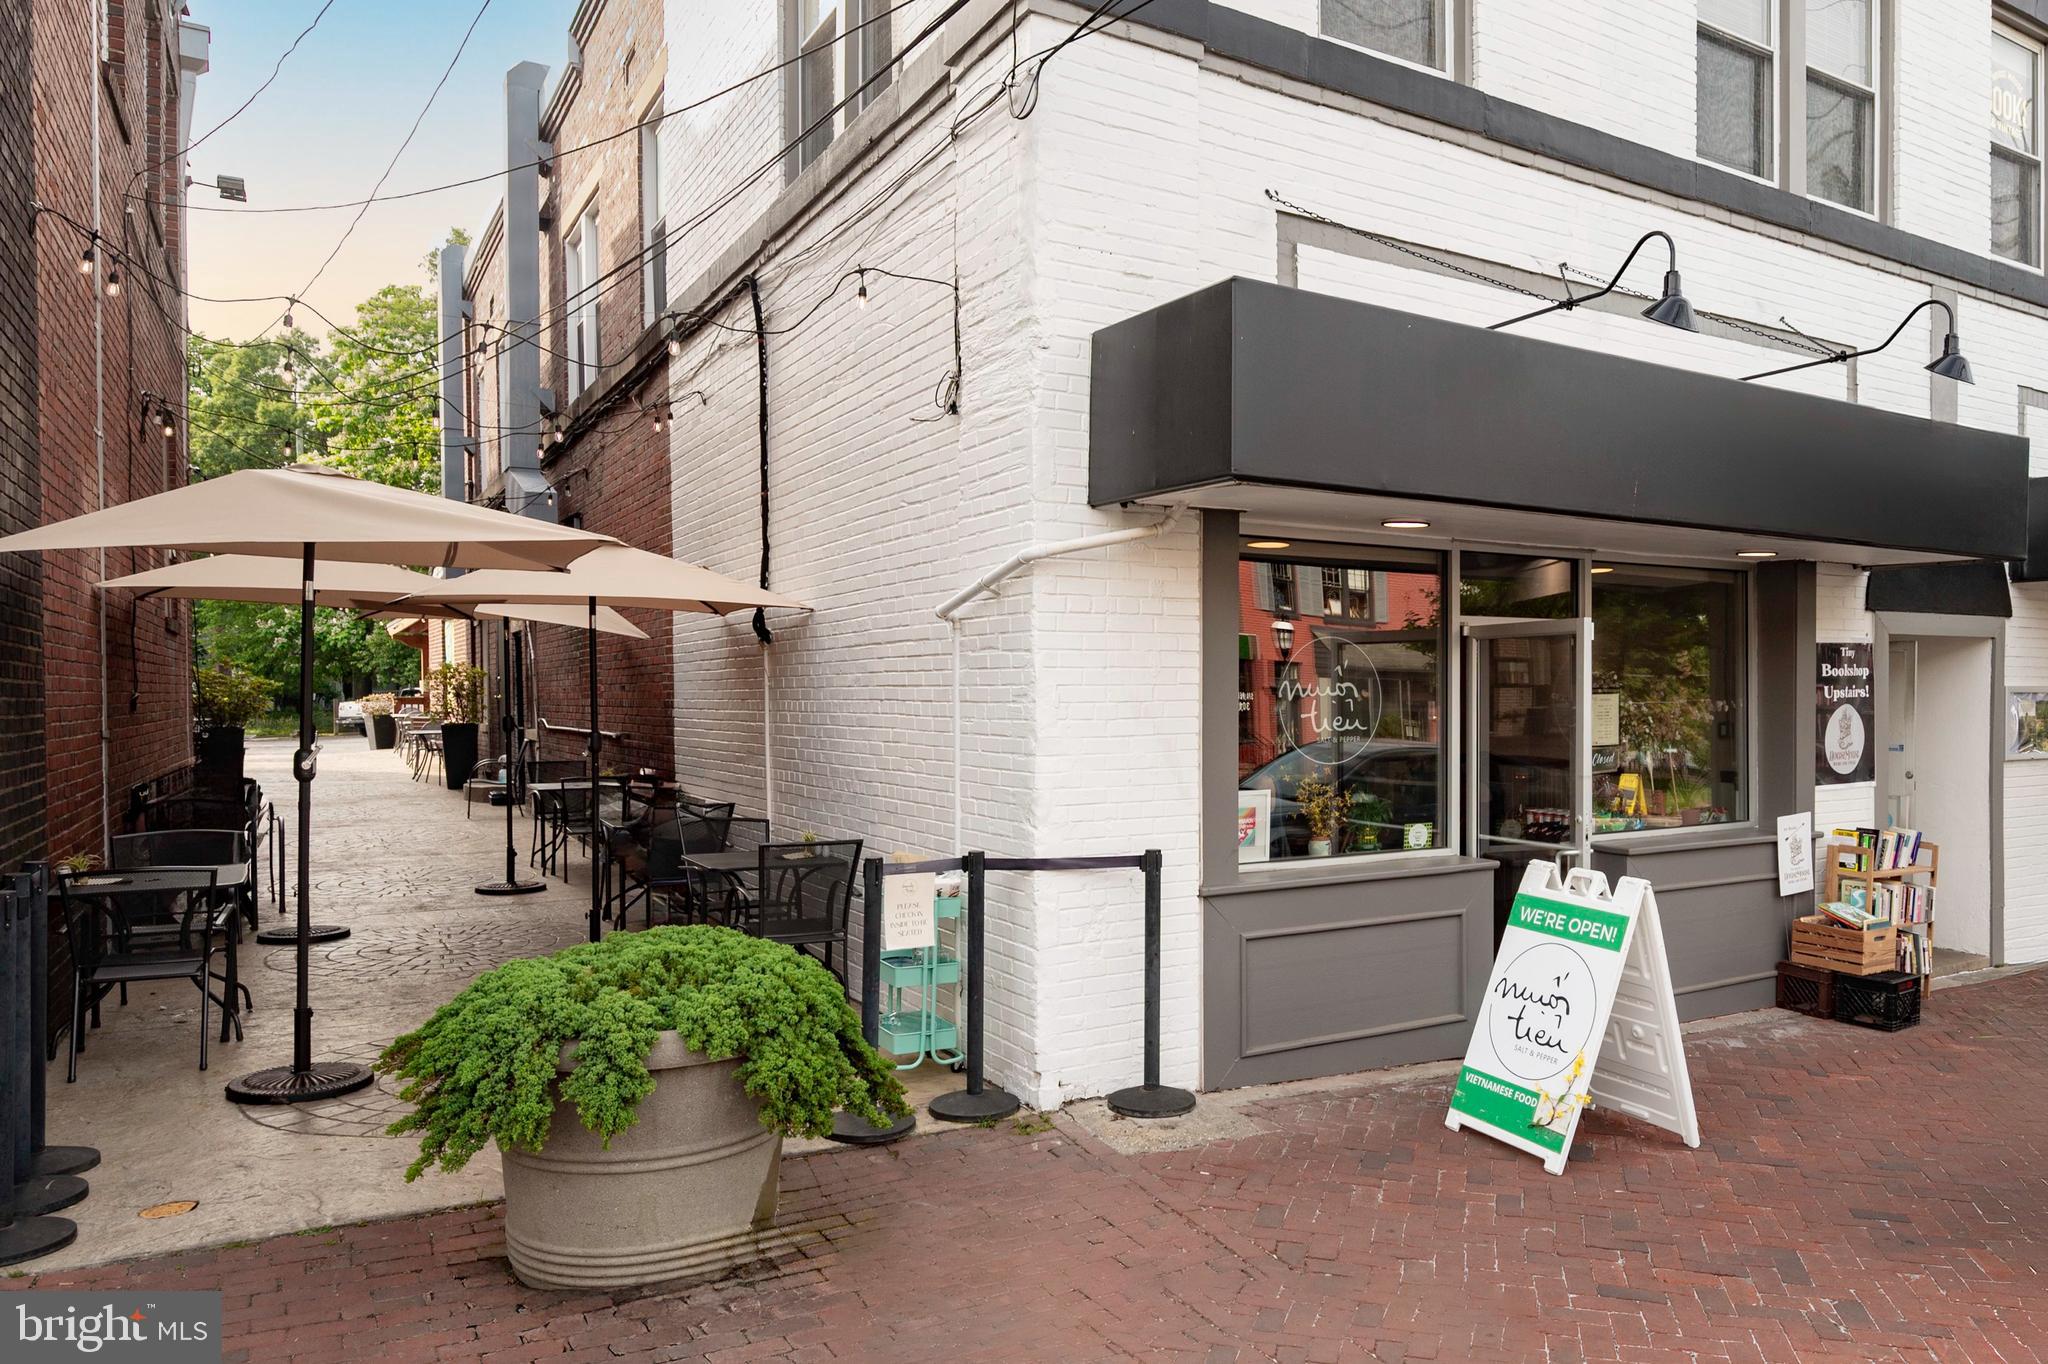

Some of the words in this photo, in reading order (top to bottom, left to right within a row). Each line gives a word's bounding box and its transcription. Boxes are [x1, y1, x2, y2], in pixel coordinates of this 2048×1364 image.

[1840, 646, 1856, 659] Tiny
[1821, 663, 1870, 680] Bookshop
[1823, 684, 1870, 702] Upstairs!
[1592, 753, 1615, 767] Closed
[1520, 906, 1567, 931] WE'RE
[1568, 918, 1618, 943] OPEN!
[1513, 1044, 1528, 1054] SALT
[1536, 1052, 1559, 1065] PEPPER
[1465, 1072, 1514, 1098] VIETNAMESE
[1514, 1091, 1538, 1107] FOOD
